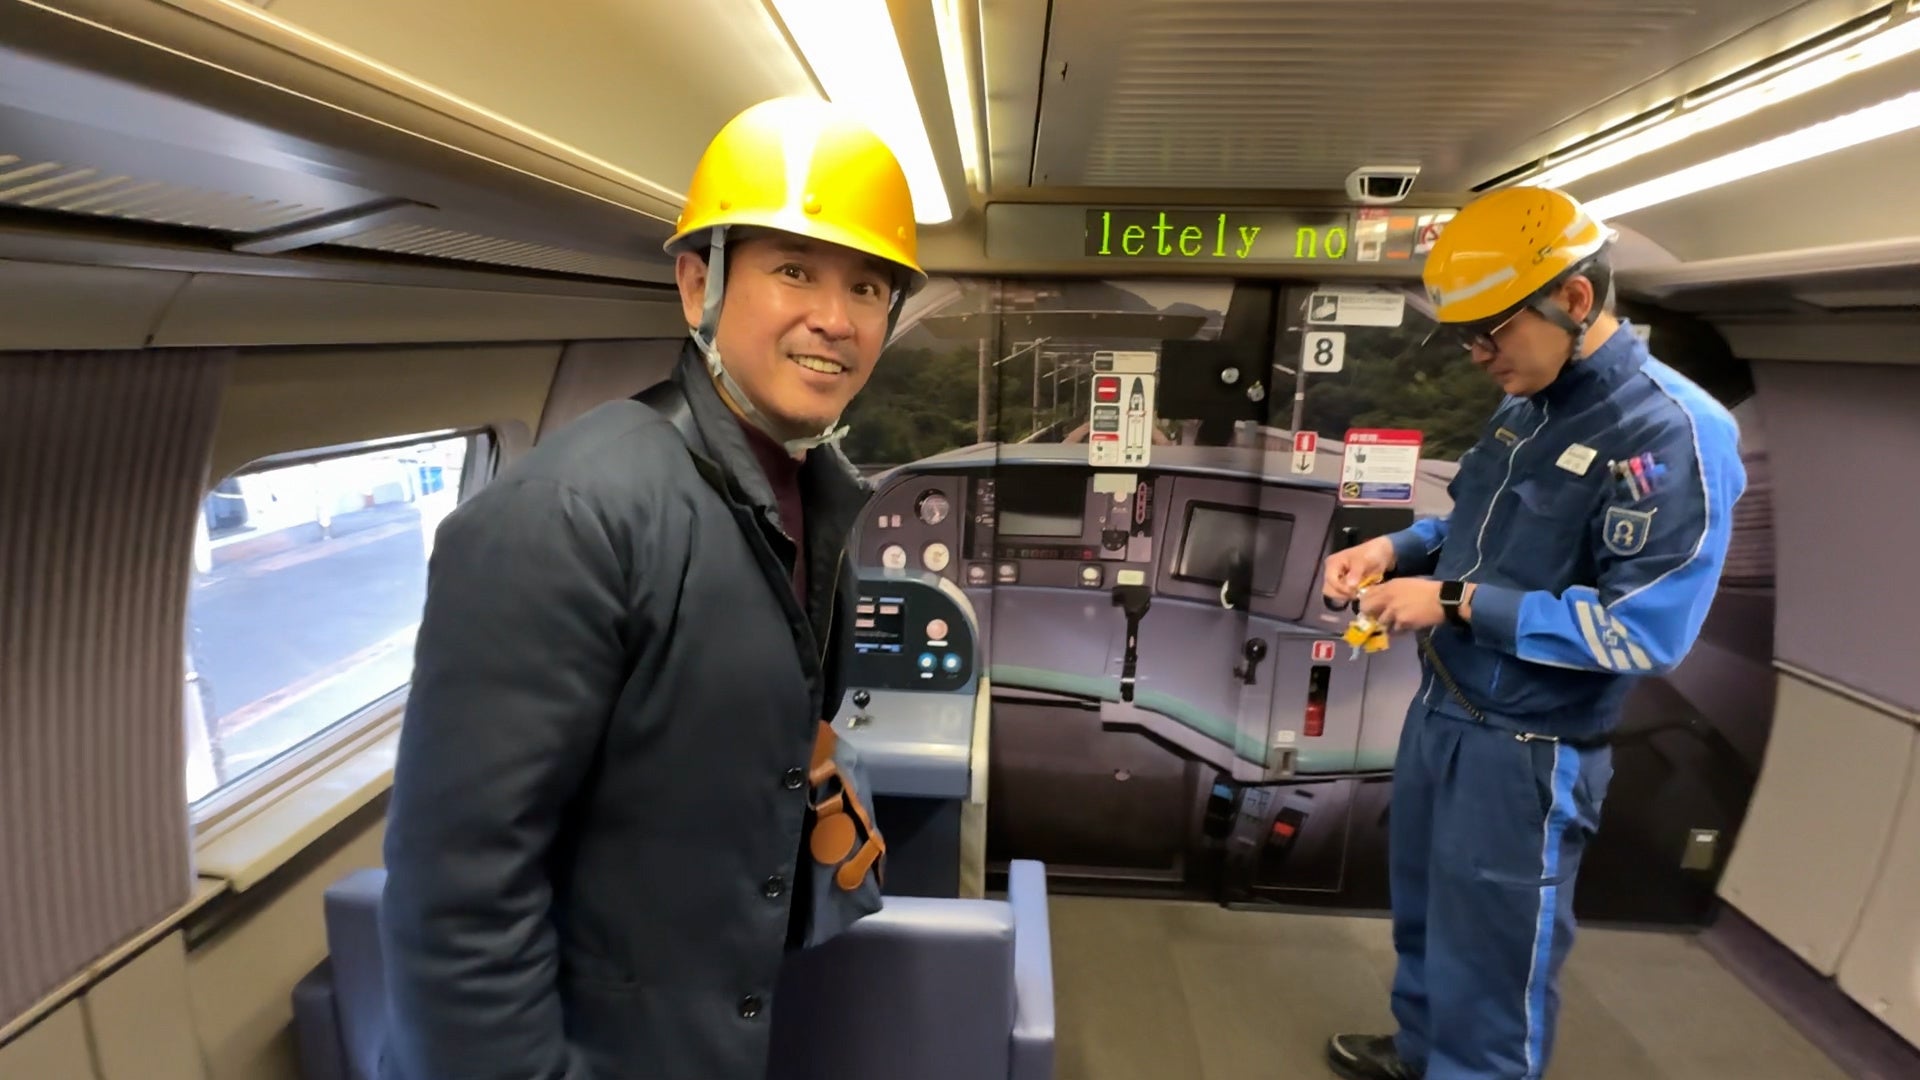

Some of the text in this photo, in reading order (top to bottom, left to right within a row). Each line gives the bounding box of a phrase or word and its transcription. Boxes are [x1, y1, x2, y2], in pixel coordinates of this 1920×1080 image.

[1098, 212, 1347, 258] letely no
[1314, 338, 1334, 366] 8
